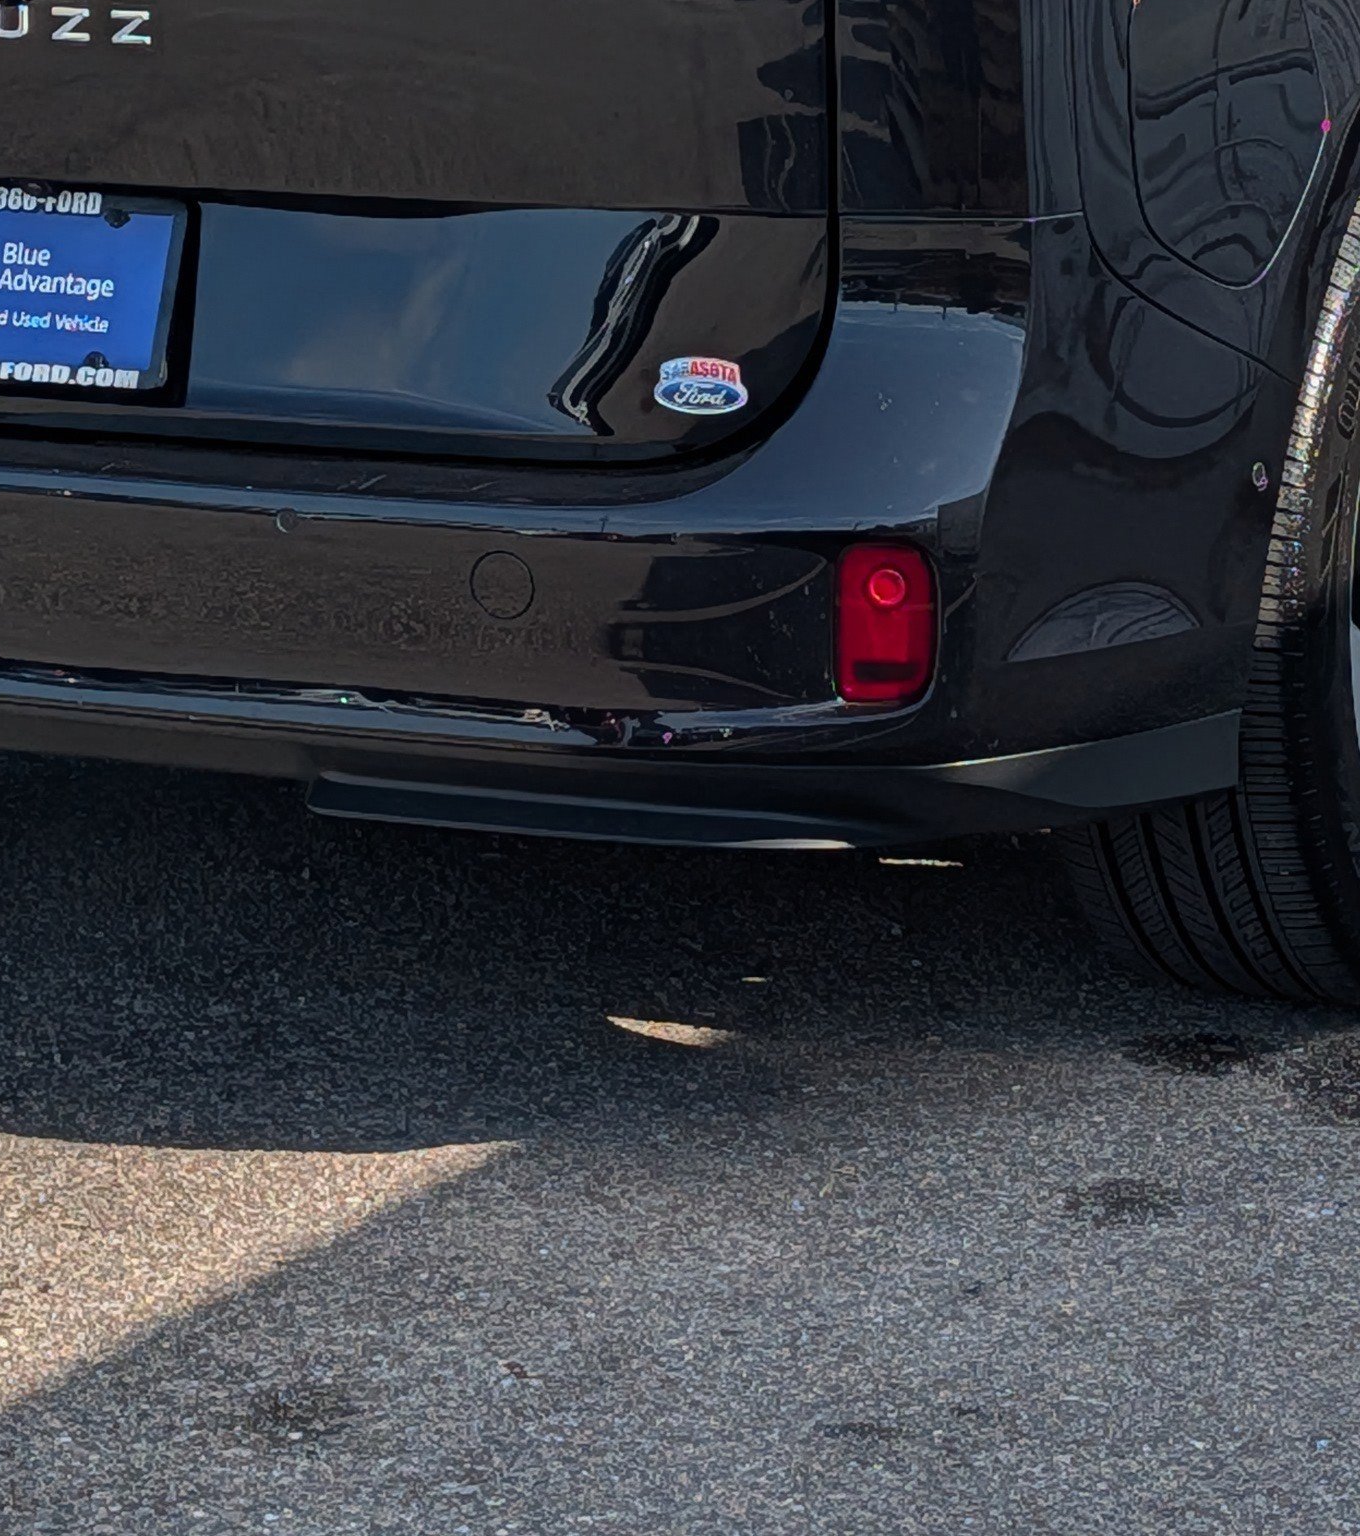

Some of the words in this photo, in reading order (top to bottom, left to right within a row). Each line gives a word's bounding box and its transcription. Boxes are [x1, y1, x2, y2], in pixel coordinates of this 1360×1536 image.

[3, 242, 51, 267] Blue
[12, 311, 52, 329] Used
[55, 314, 110, 333] Vehicle
[672, 382, 727, 406] Ford
